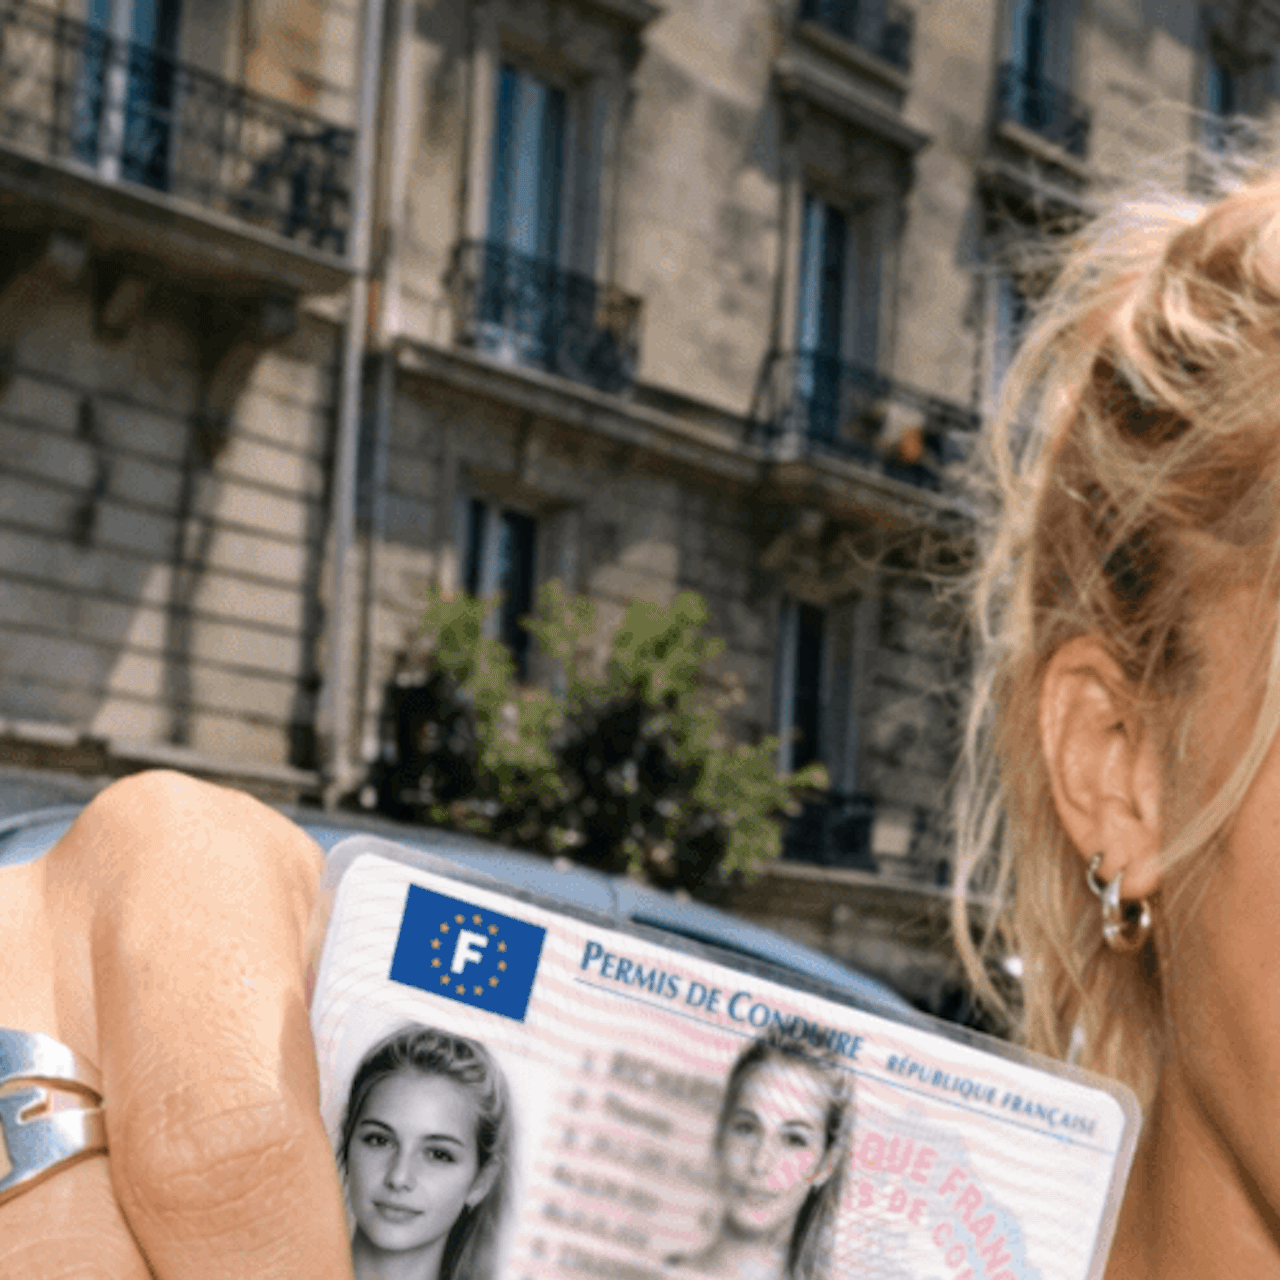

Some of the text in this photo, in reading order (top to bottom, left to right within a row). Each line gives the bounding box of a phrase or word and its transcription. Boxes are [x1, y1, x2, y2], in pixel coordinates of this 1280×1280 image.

[450, 928, 489, 975] F
[580, 939, 865, 1061] PERMIS DE CONDUIRE
[886, 1053, 1098, 1136] RÉPUBLIQUE FRANÇAISE
